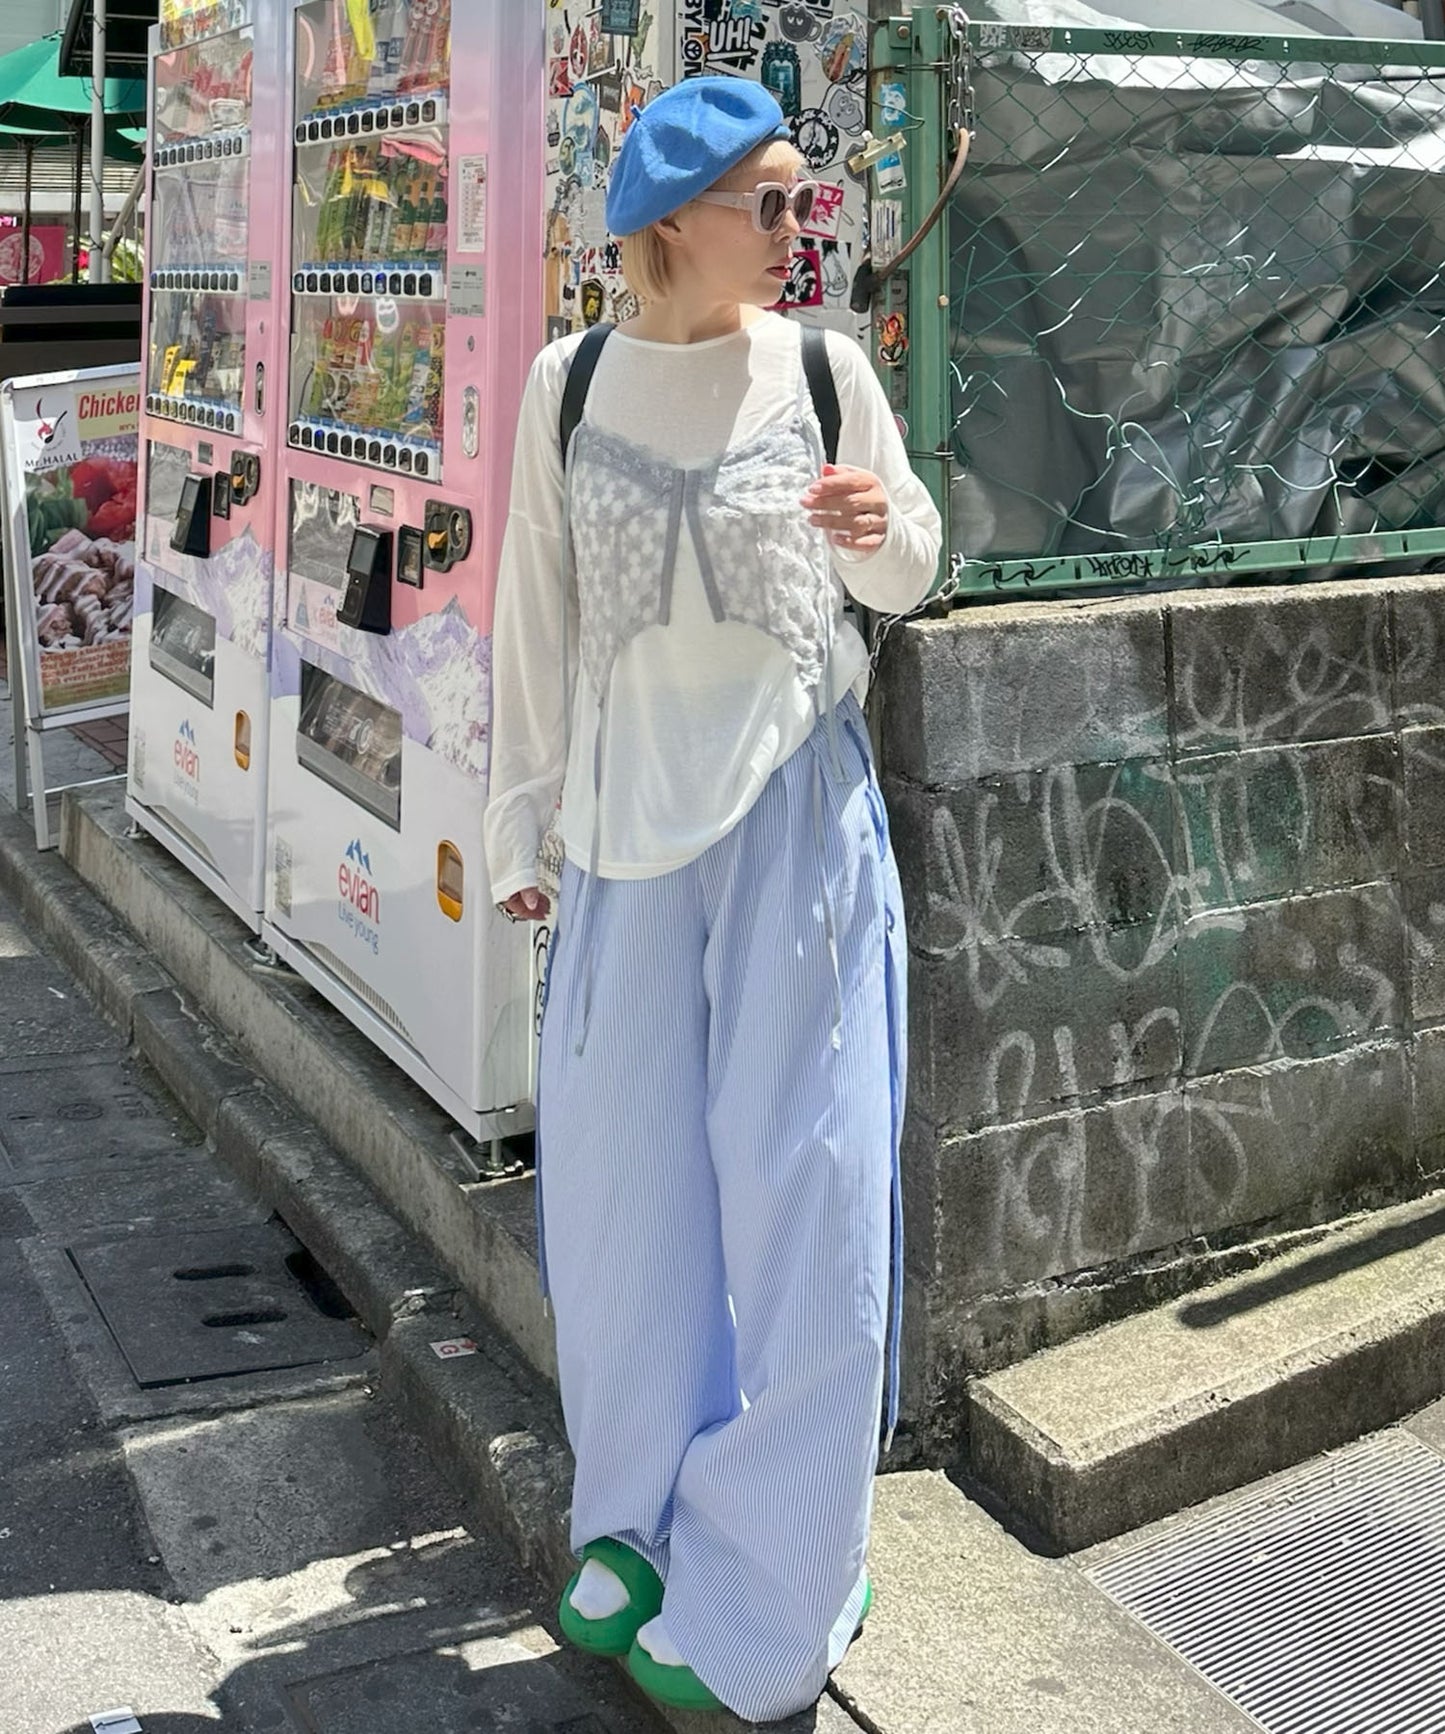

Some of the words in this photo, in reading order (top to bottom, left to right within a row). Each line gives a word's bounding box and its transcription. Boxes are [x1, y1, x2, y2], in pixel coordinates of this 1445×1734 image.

[709, 17, 751, 52] UH!
[79, 391, 140, 420] Chicke
[174, 739, 200, 782] evian
[338, 863, 380, 924] evian
